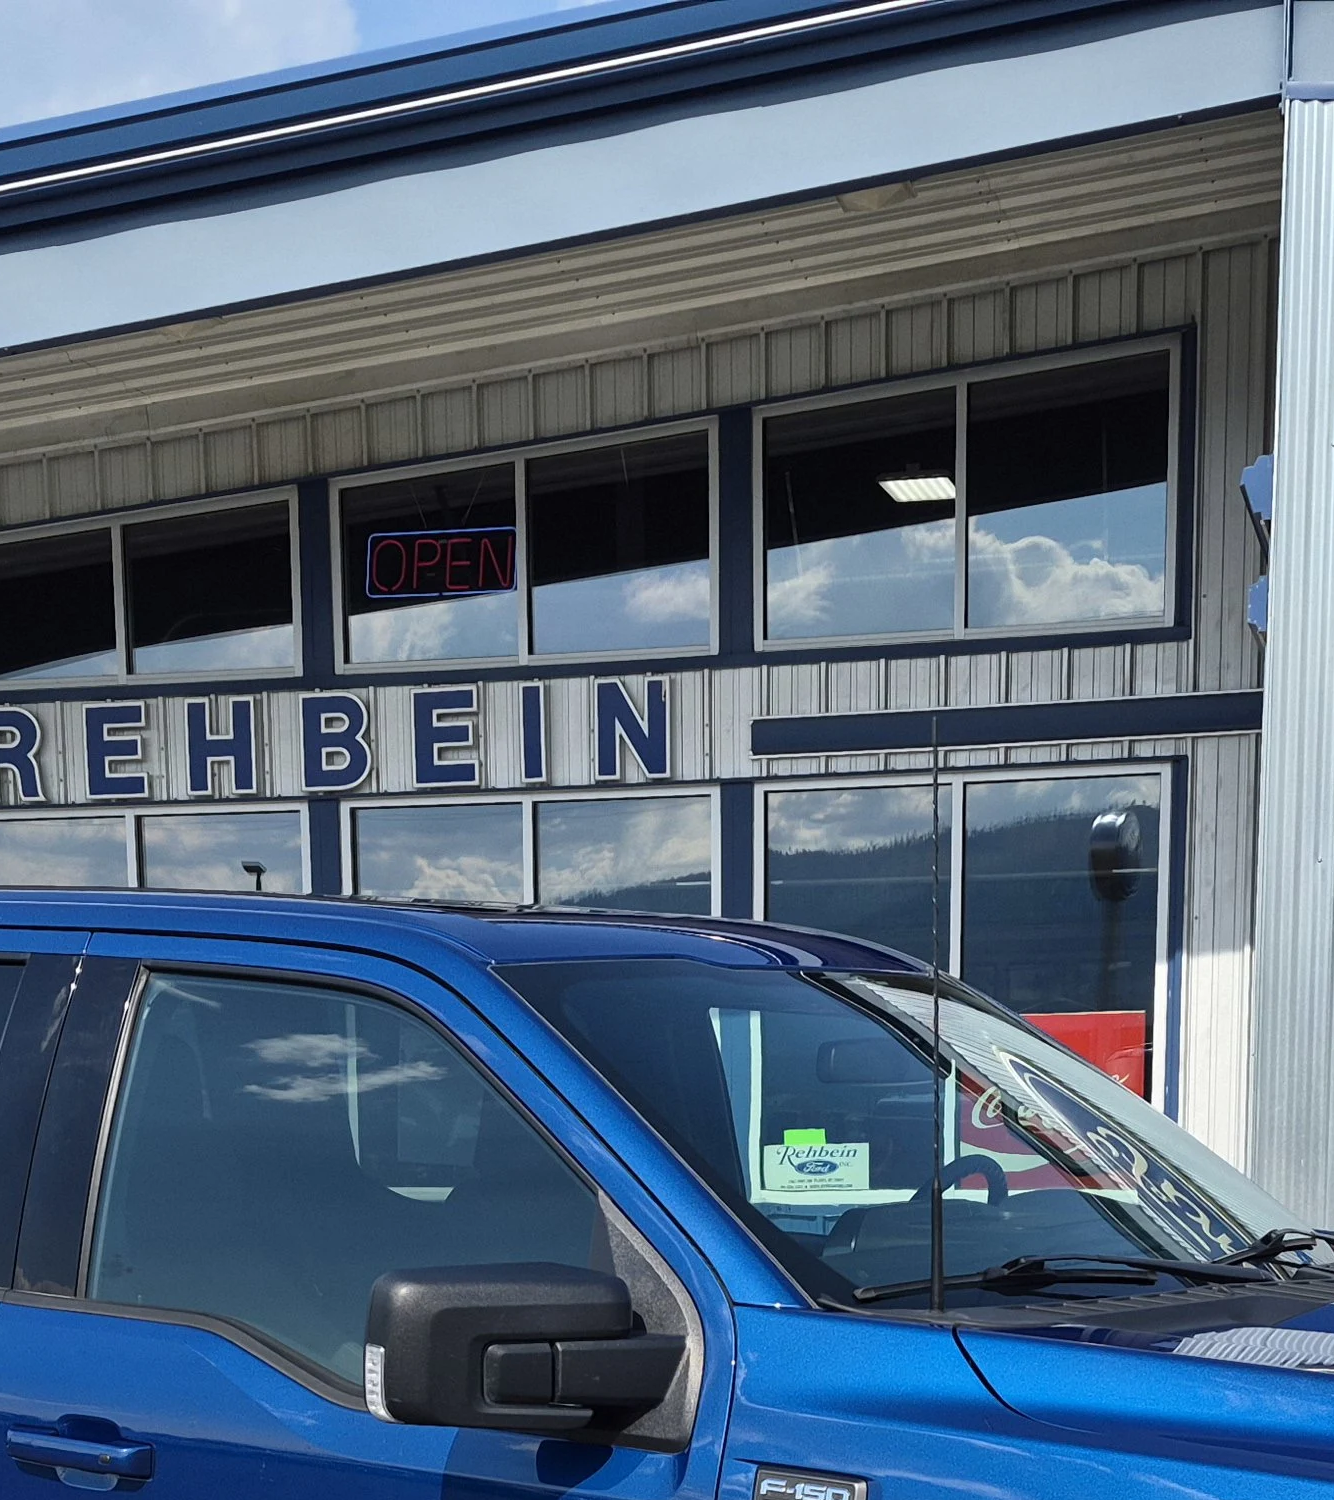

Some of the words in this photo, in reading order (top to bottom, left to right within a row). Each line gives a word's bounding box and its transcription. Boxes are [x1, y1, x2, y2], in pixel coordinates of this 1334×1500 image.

[372, 536, 513, 591] OPEN
[776, 1145, 858, 1168] Rehbein
[802, 1161, 830, 1173] Ford
